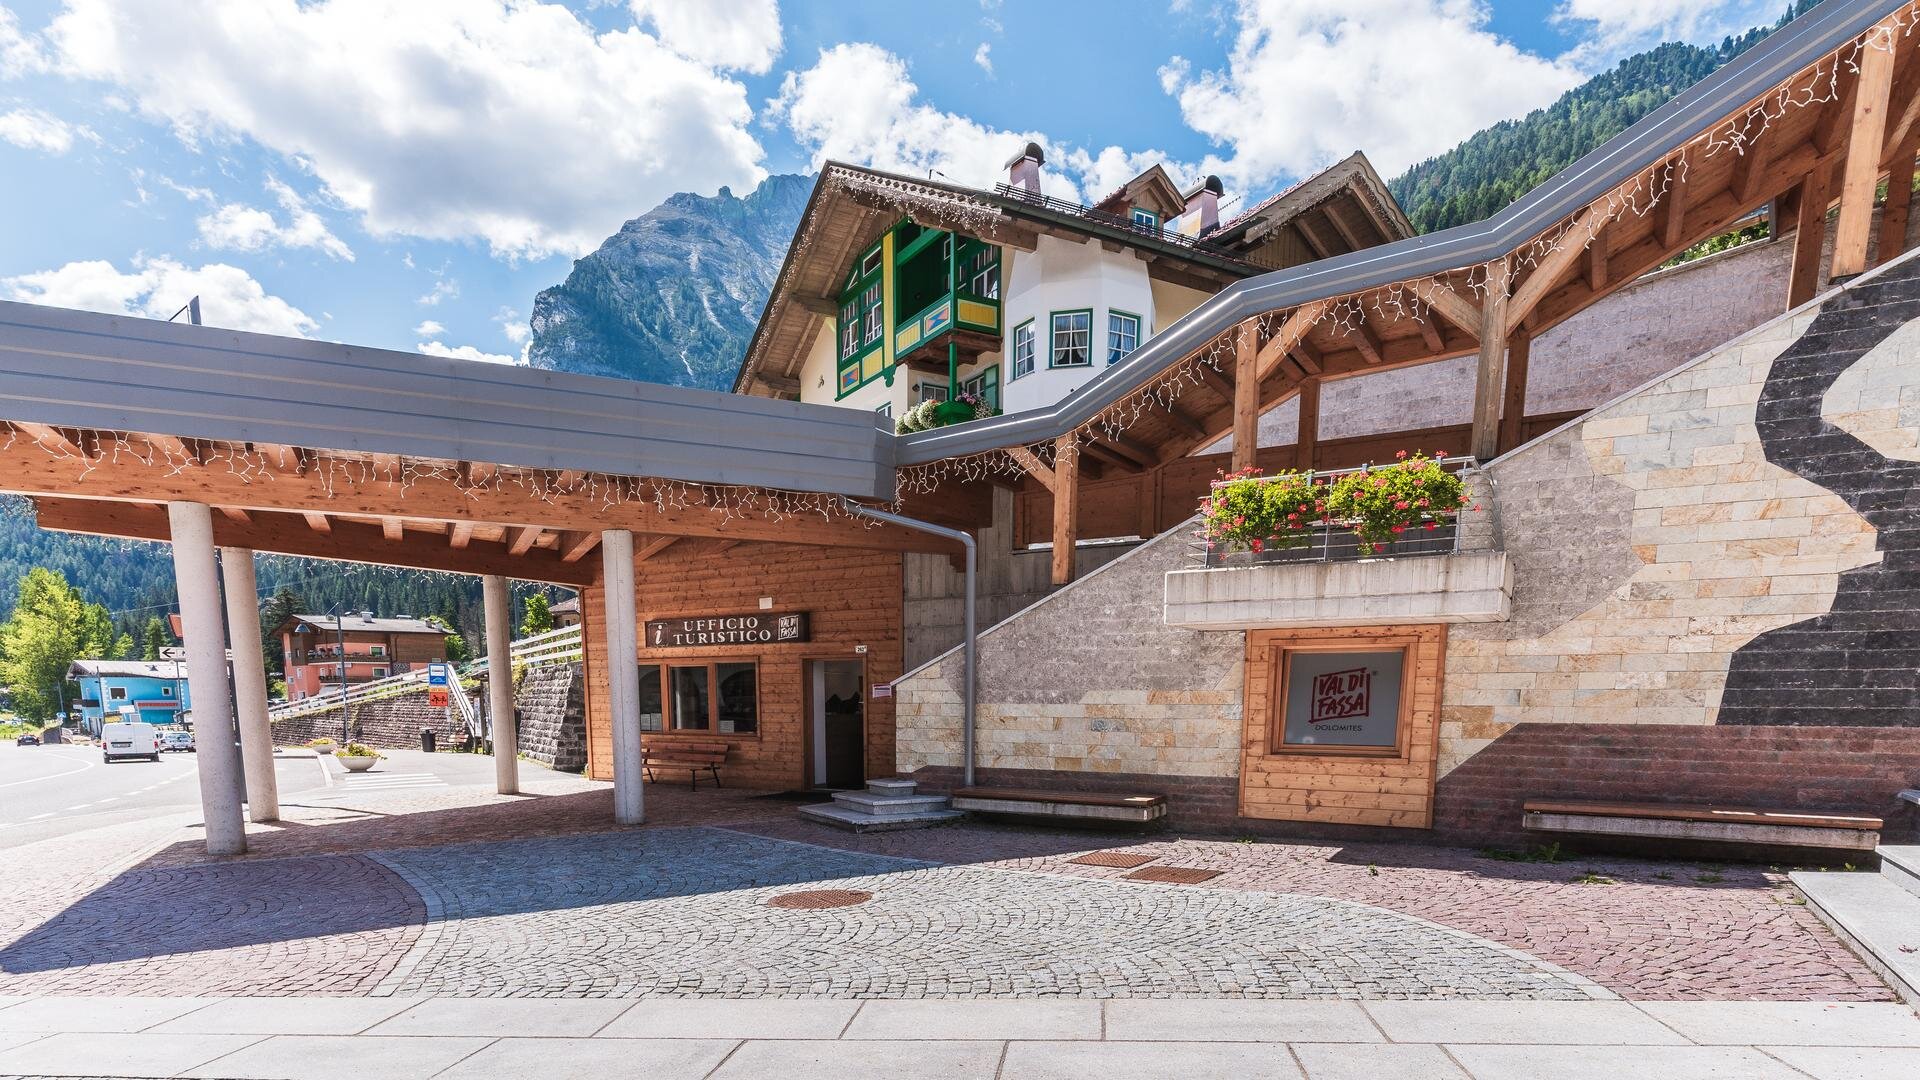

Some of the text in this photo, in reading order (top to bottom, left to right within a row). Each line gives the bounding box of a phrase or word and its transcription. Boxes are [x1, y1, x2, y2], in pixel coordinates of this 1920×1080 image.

[683, 617, 758, 632] UFFICIO
[780, 626, 797, 638] FASSA
[673, 629, 771, 645] TURISTICO
[1319, 671, 1364, 696] VAL DI
[1317, 692, 1364, 717] FASSA
